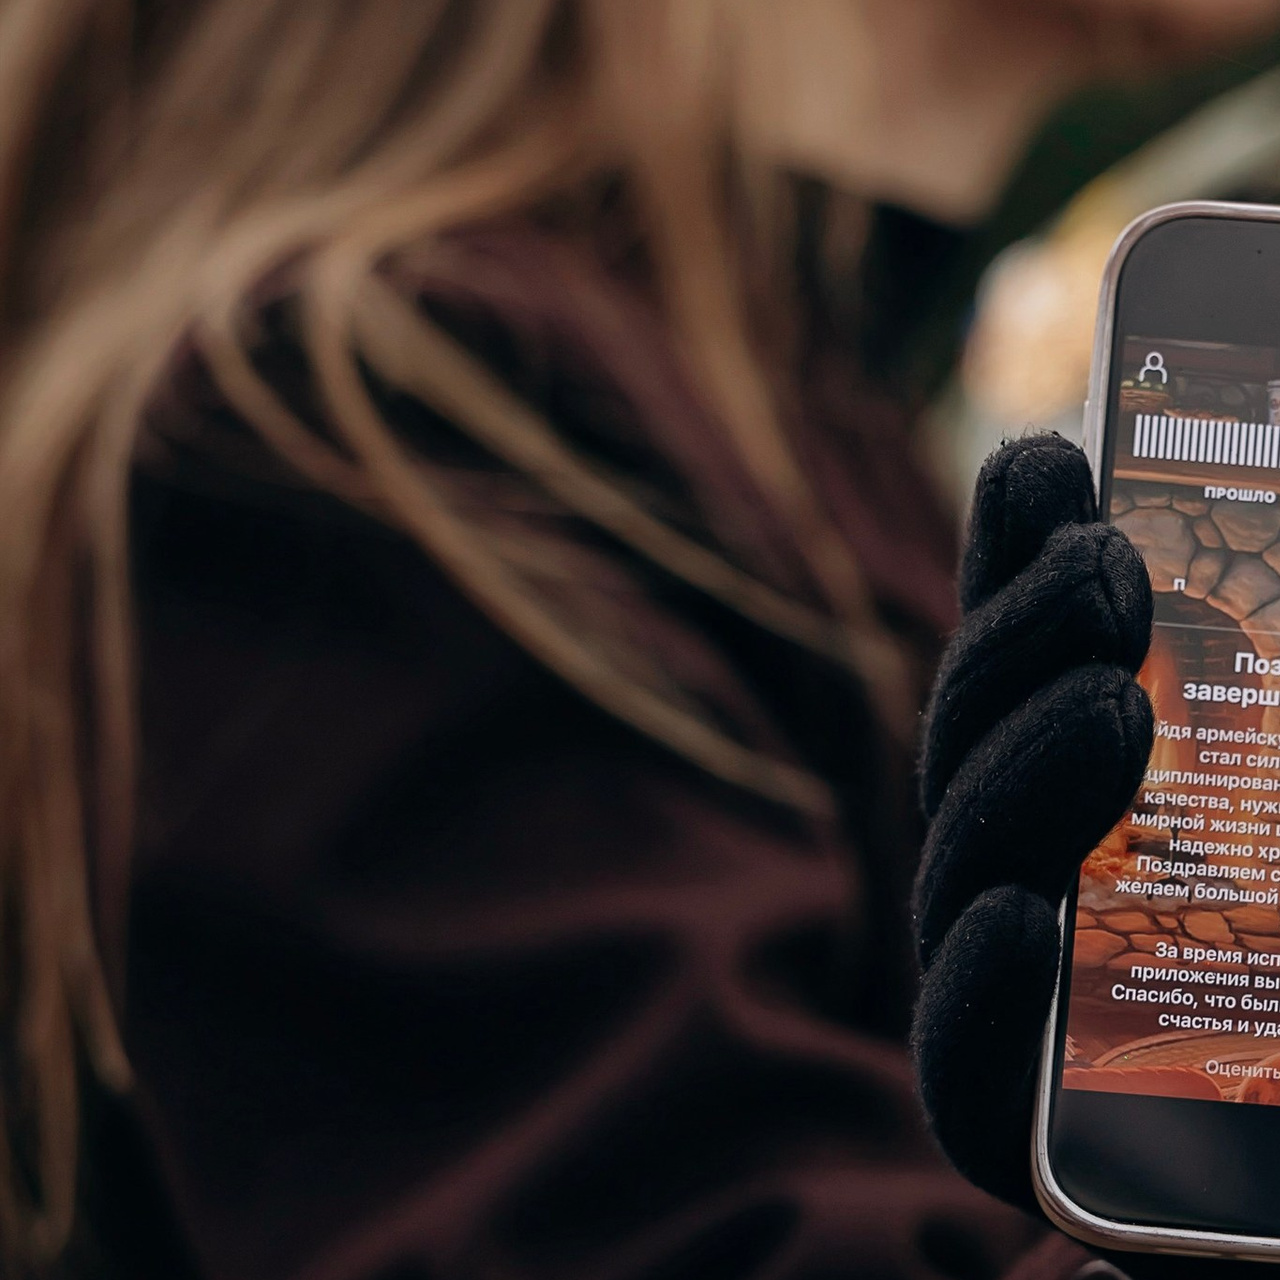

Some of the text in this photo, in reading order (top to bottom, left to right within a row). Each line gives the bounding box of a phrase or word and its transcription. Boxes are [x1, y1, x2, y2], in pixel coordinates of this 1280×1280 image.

[1156, 721, 1191, 740] йдя
[1199, 749, 1241, 765] стал
[1144, 791, 1234, 813] качества,
[1131, 812, 1205, 831] мирной
[1209, 818, 1271, 835] жизни
[1169, 838, 1253, 858] надежно
[1136, 855, 1265, 882] Поздравляем
[1115, 879, 1190, 898] желаем
[1194, 883, 1279, 905] большой
[1155, 942, 1178, 959] За
[1183, 946, 1243, 963] время
[1131, 965, 1250, 987] приложения
[1254, 976, 1280, 989] вы
[1111, 984, 1199, 1009] Спасибо,
[1204, 994, 1236, 1009] что
[1158, 1013, 1232, 1032] счастья
[1237, 1020, 1249, 1032] и
